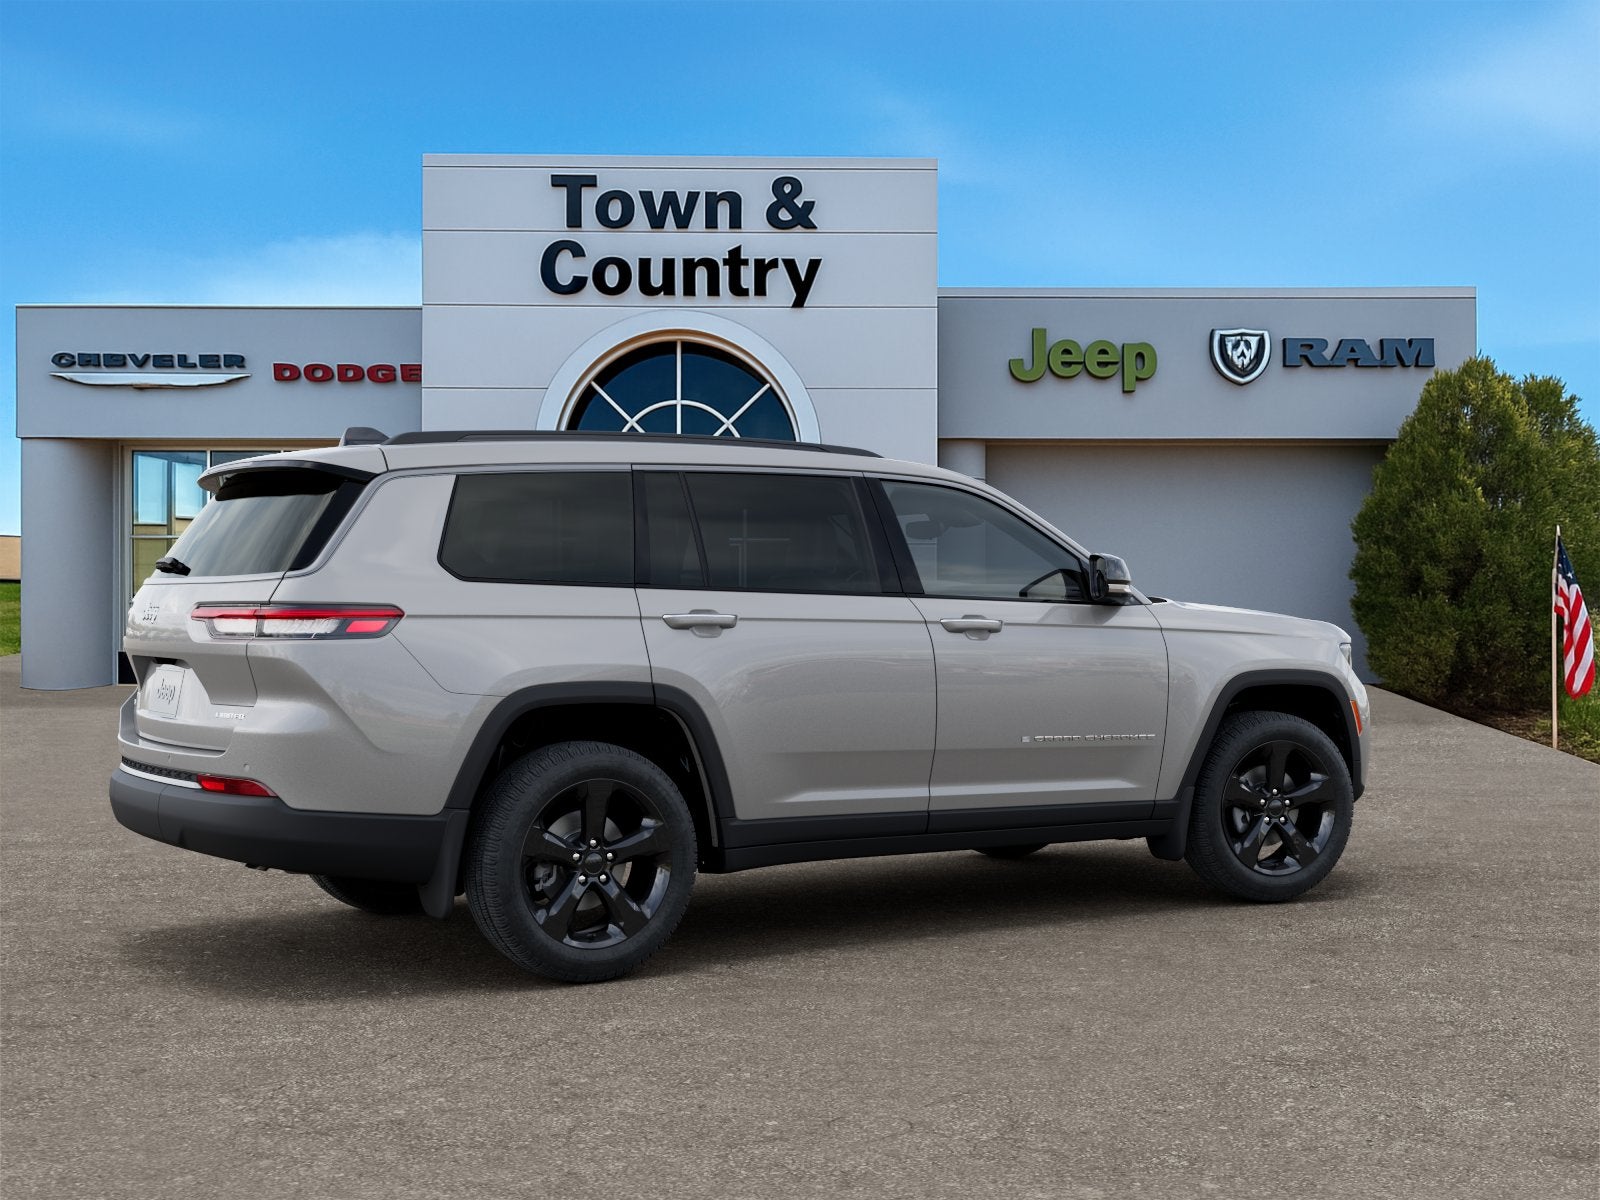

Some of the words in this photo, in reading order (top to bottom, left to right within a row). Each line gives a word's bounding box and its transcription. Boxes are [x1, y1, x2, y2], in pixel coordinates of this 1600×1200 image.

[550, 173, 743, 230] Town
[765, 175, 819, 230] &
[540, 239, 823, 309] Country
[272, 362, 422, 383] DODGE
[1009, 327, 1158, 393] Jeep
[1282, 337, 1436, 368] RAM
